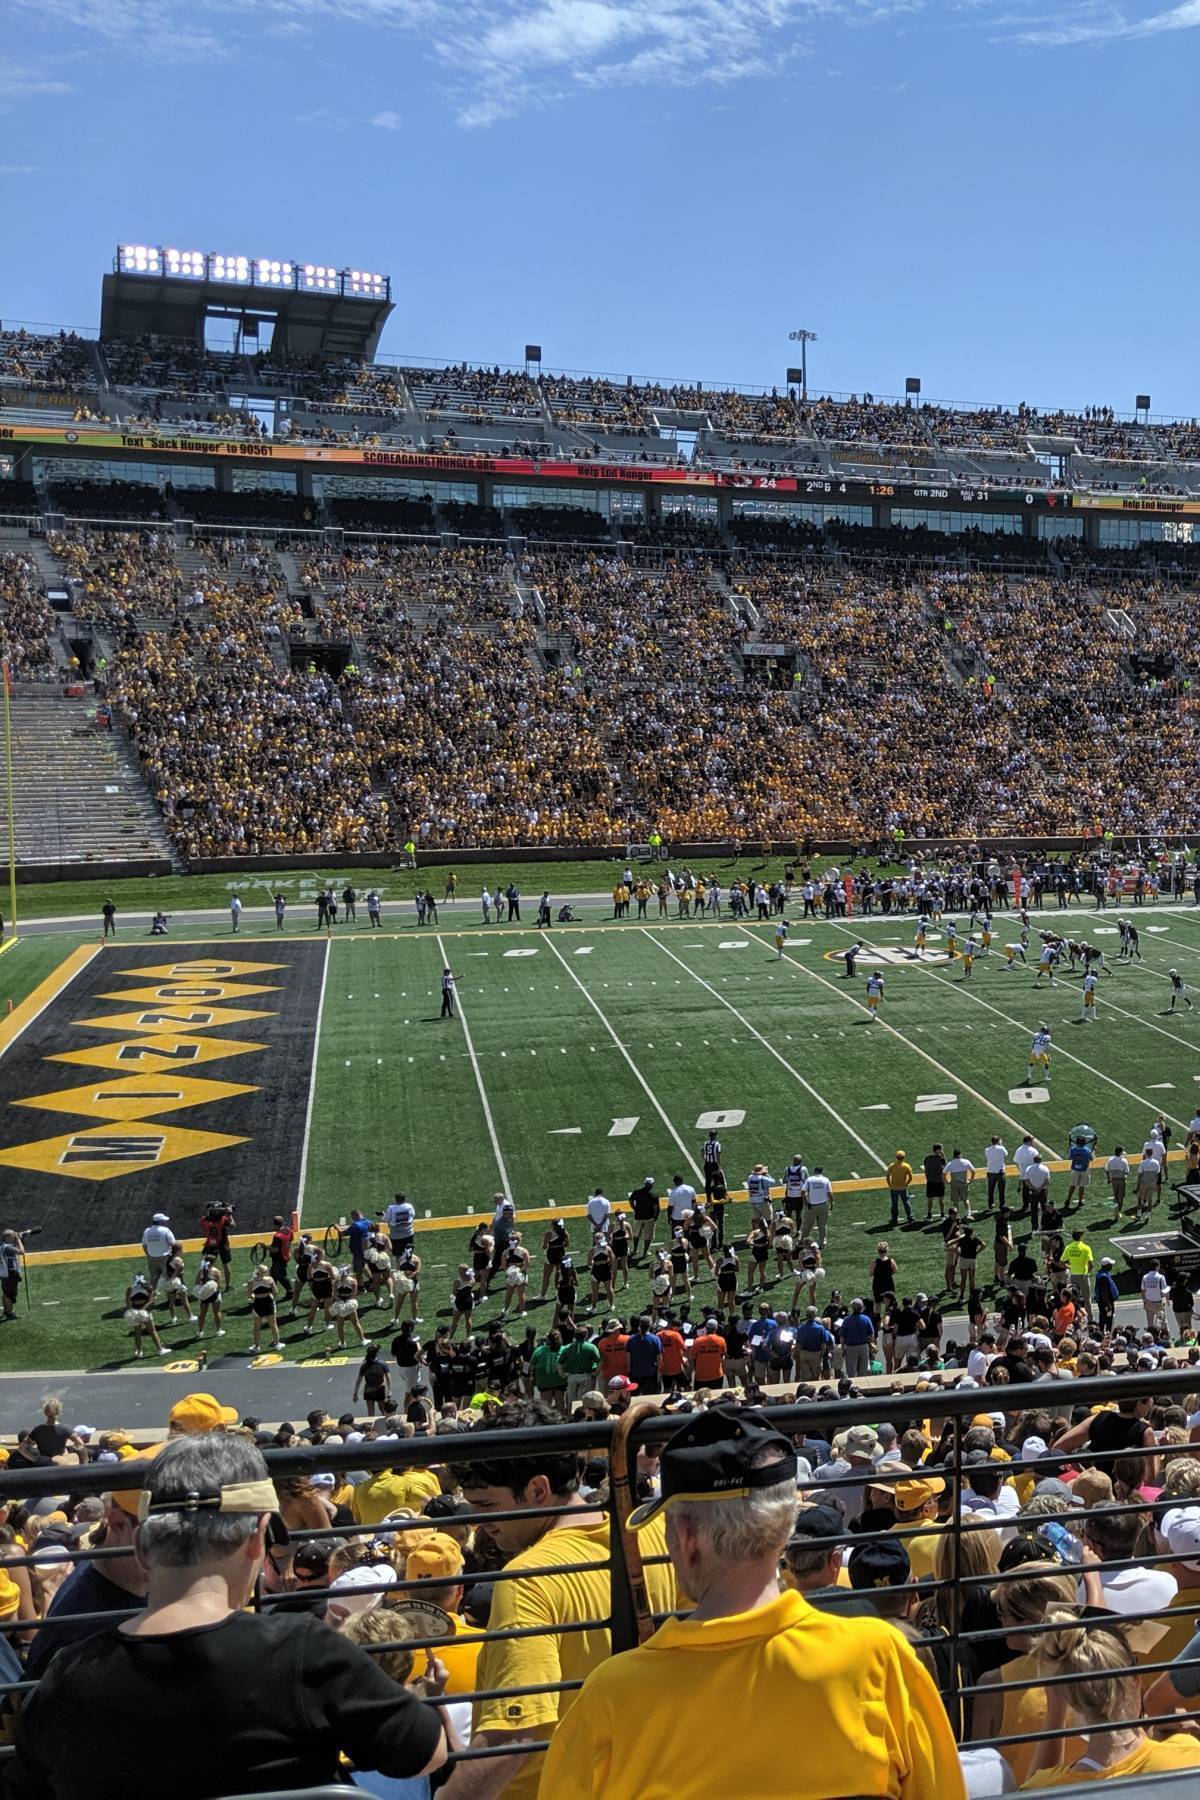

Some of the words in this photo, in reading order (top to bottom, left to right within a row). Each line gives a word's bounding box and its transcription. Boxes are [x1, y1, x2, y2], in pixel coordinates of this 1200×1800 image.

[120, 435, 144, 448] Text
[146, 436, 178, 450] "Sack
[180, 438, 225, 454] Hunger"
[226, 442, 238, 453] to
[239, 443, 274, 457] 90561
[363, 451, 497, 471] SCOREAGAINSTHUNGER.ORG
[577, 465, 600, 478] Help
[601, 467, 618, 478] End
[619, 469, 653, 481] Hunger
[760, 477, 777, 489] 24
[806, 479, 824, 492] 2ND
[839, 483, 847, 494] 4
[869, 485, 895, 497] 1:26
[914, 488, 930, 498] QTR
[930, 488, 949, 499] 2ND
[977, 491, 989, 502] 31
[1025, 493, 1034, 505] 0
[1122, 500, 1140, 511] Help
[1142, 500, 1155, 510] End
[1157, 501, 1184, 512] Hunger
[706, 1145, 713, 1155] S
